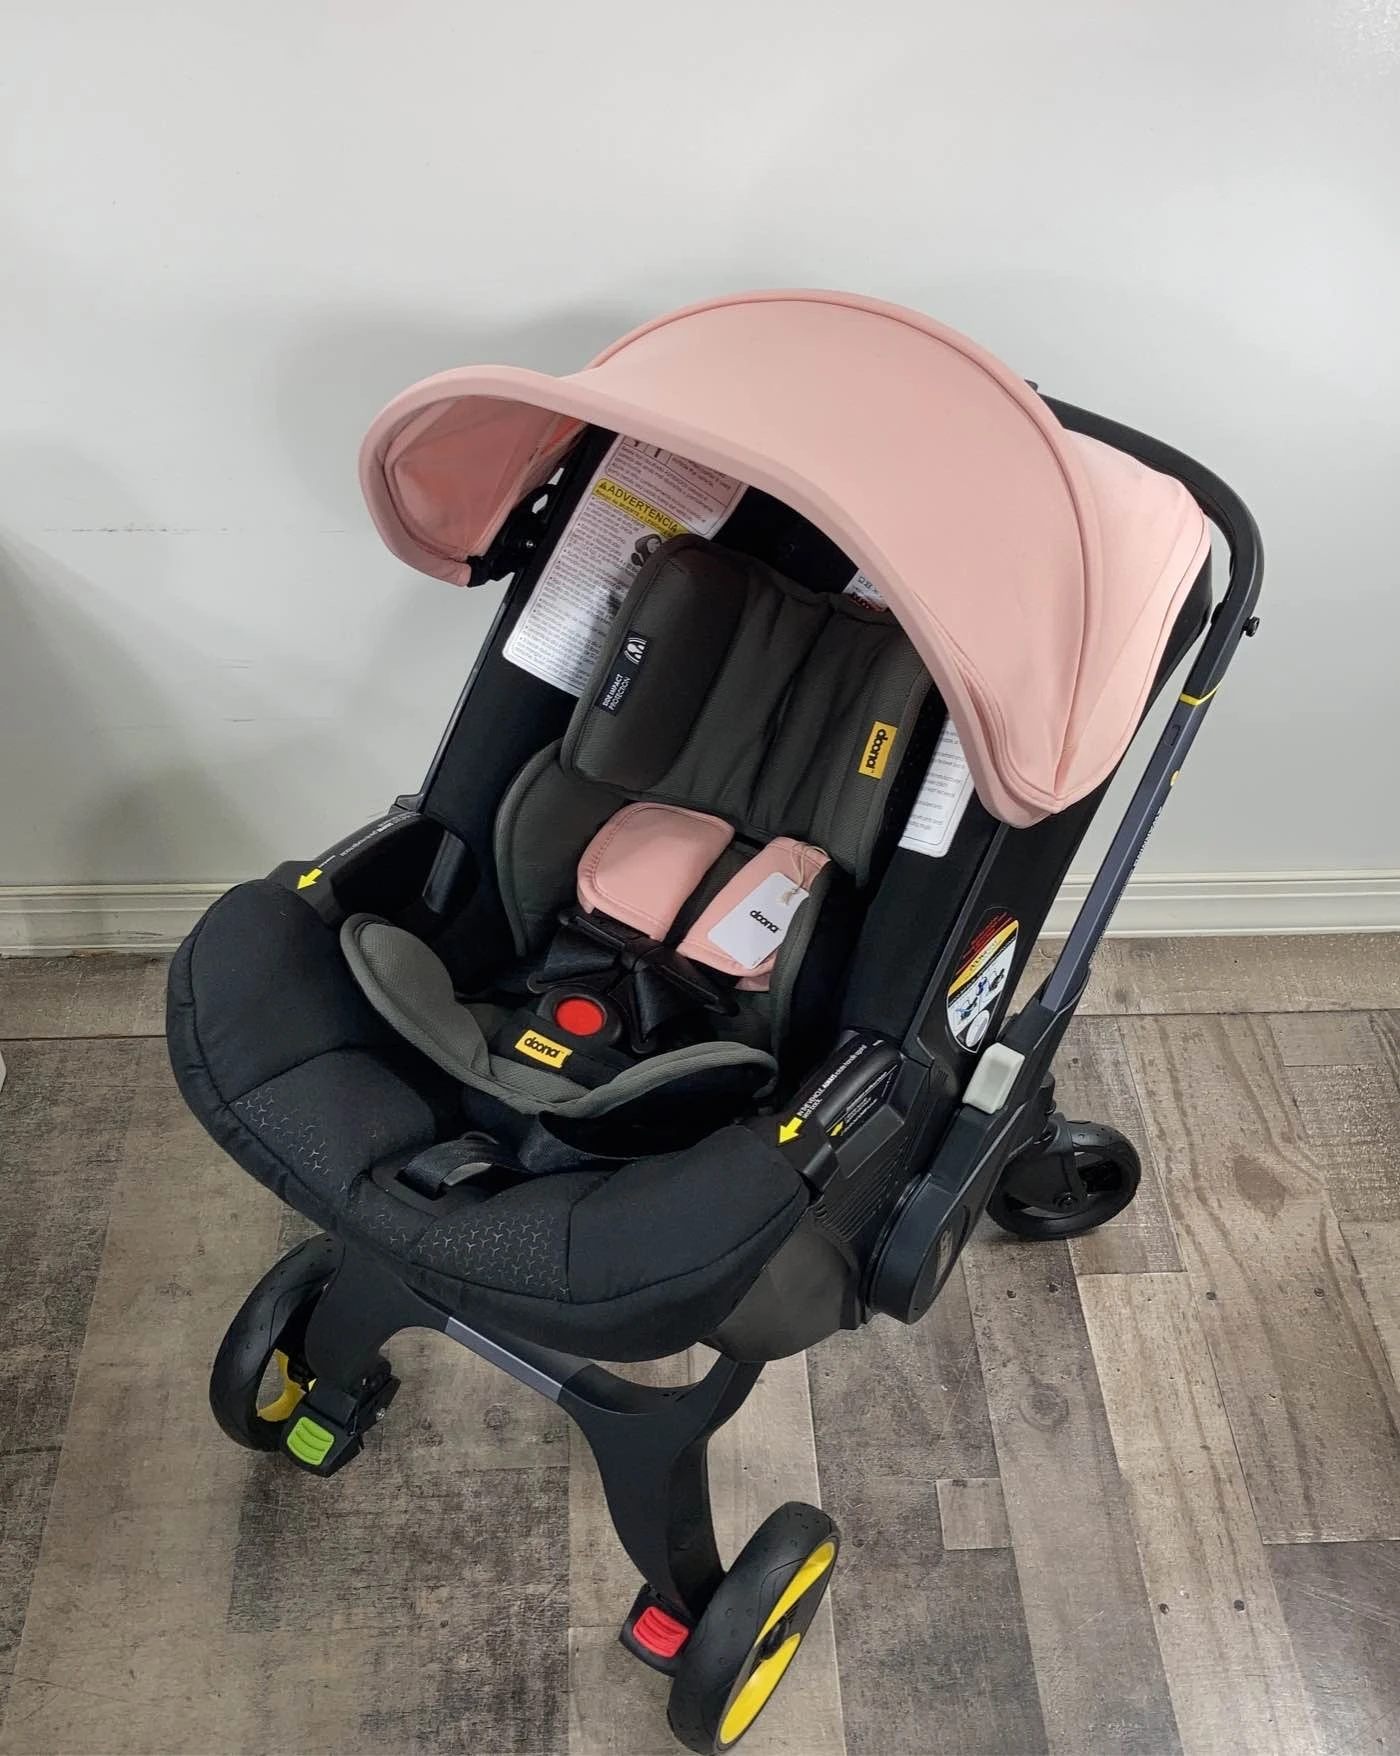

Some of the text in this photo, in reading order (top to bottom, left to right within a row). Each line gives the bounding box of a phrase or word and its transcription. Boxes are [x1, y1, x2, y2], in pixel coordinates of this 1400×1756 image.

[606, 483, 678, 532] ADVERTENCIA
[602, 673, 623, 706] SIDE IMPACT
[608, 675, 630, 710] PROTECTION
[866, 729, 888, 768] doona
[750, 909, 779, 933] doona
[524, 1036, 561, 1058] doona
